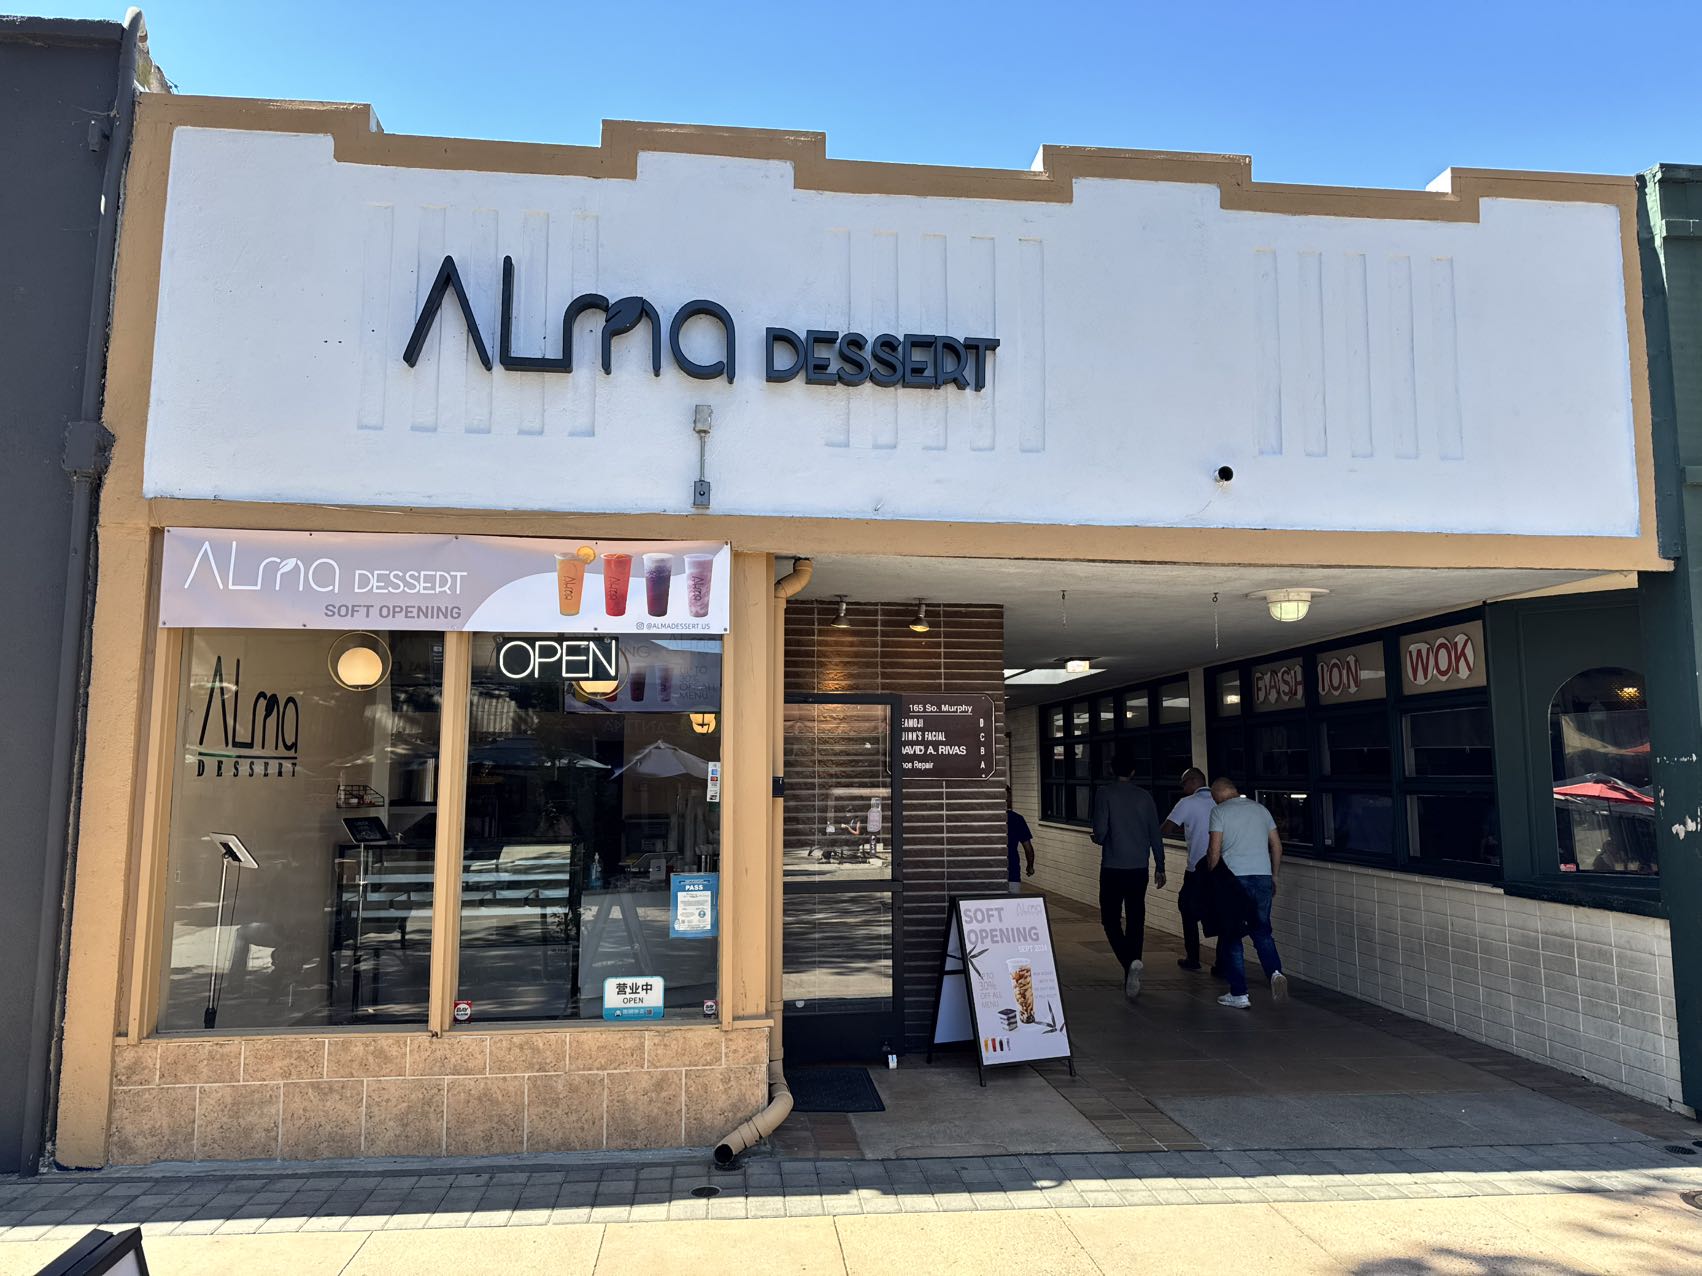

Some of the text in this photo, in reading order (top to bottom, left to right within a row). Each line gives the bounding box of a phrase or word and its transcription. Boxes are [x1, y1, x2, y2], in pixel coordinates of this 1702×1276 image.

[765, 326, 1001, 393] DESSERT
[354, 569, 467, 594] DESSERT
[324, 603, 462, 620] SOFT OPENING
[499, 639, 616, 679] OPEN
[1318, 658, 1361, 693] ION
[1407, 638, 1473, 682] WOK
[909, 704, 973, 714] 165 So. Murphy
[979, 718, 984, 727] D
[924, 732, 946, 741] FACIAL
[979, 732, 985, 742] C
[926, 746, 937, 755] A.
[938, 746, 967, 755] RIVAS
[980, 746, 985, 755] B
[197, 759, 298, 777] DESSERT
[914, 760, 934, 771] Repair
[980, 760, 986, 769] A
[963, 907, 1004, 925] SOFT
[966, 926, 1040, 946] OPENING
[616, 982, 653, 996] 营业中
